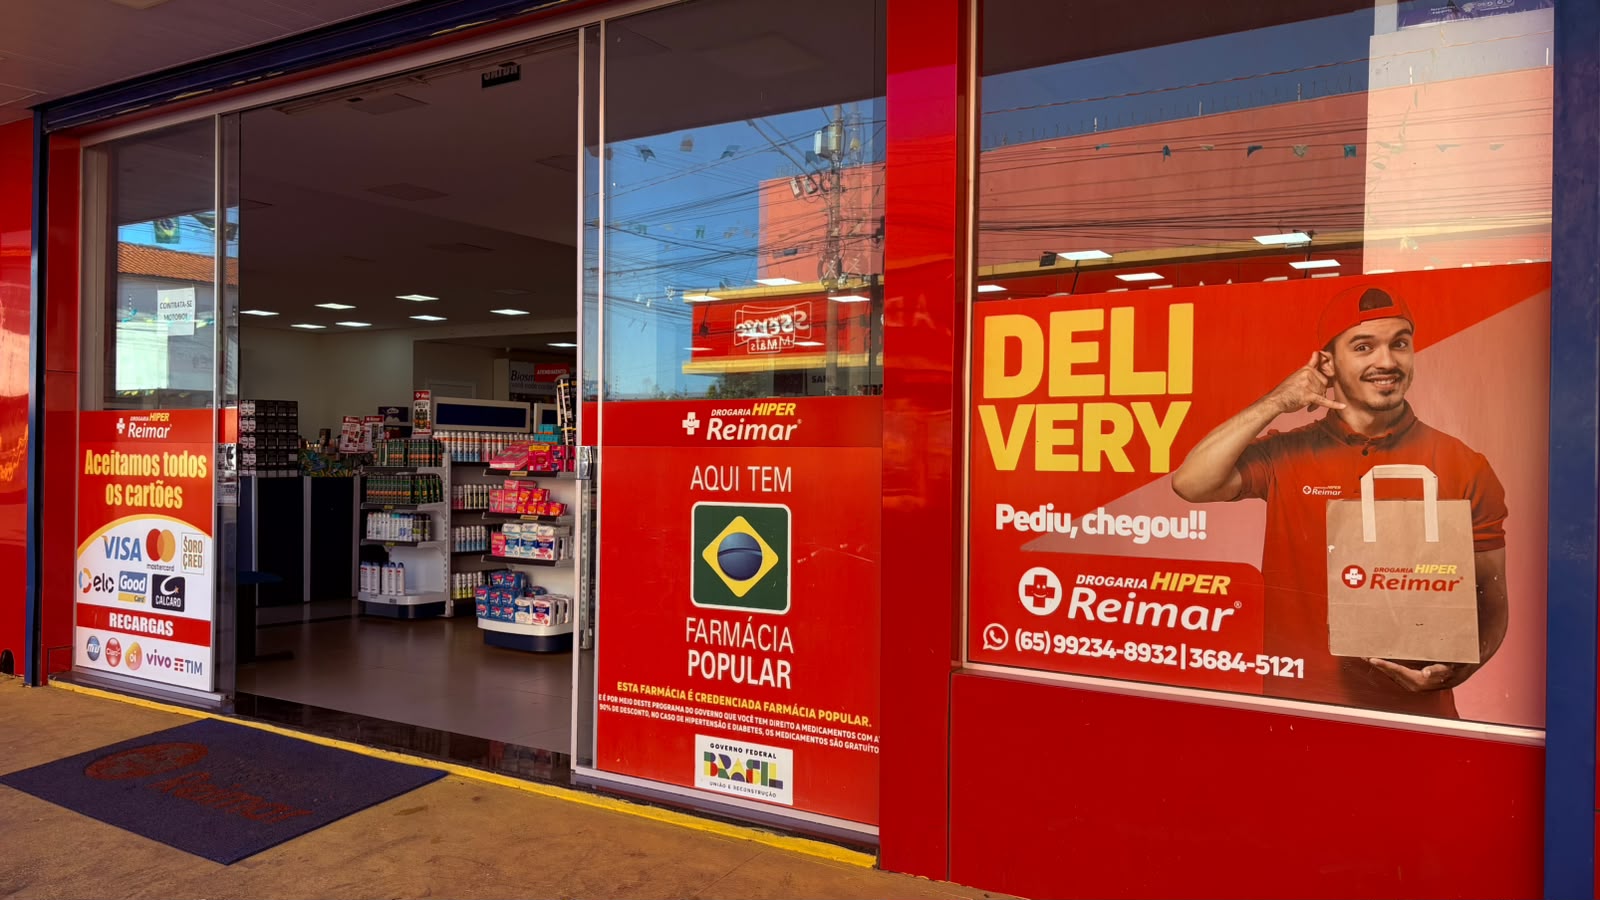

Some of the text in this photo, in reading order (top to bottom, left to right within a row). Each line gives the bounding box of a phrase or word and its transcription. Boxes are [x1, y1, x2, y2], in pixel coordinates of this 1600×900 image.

[159, 300, 192, 309] CONTRATA-SE
[983, 302, 1194, 399] DELI
[149, 412, 170, 422] HIPER
[752, 403, 796, 416] HIPER
[128, 422, 170, 438] Reimar
[706, 418, 798, 441] Reimar
[978, 400, 1192, 473] VERY
[84, 450, 207, 478] Aceitamos todos
[690, 466, 792, 492] AQUI TEM
[106, 480, 183, 510] os cartões
[996, 504, 1207, 544] Pediu, chegou!!
[102, 536, 142, 562] VISA
[146, 564, 174, 572] mastercard
[1414, 564, 1457, 574] HIPER
[120, 574, 146, 592] Good
[1076, 571, 1231, 596] DROGARIA HIPER
[1370, 574, 1460, 592] Reimar
[155, 595, 182, 608] CALCARD
[109, 612, 174, 637] RECARGAS
[686, 616, 794, 654] FARMÁCIA
[1014, 628, 1050, 654] (65)
[146, 649, 172, 668] vivo
[184, 660, 202, 676] TIM
[688, 650, 792, 689] POPULAR
[617, 682, 872, 728] ESTA FARMÁCIA É CREDENCIADA FARMÁCIA POPULAR.
[619, 697, 632, 705] MEIO
[634, 698, 651, 708] DESTE
[652, 701, 684, 712] PROGRAMA
[685, 707, 694, 715] DO
[694, 708, 722, 718] GOVERNO
[724, 712, 736, 721] QUE
[738, 714, 754, 724] VOCÊ
[755, 716, 768, 726] TEM
[769, 720, 794, 730] DIREITO
[802, 724, 856, 740] MEDICAMENTOS
[857, 733, 872, 742] COM
[620, 706, 650, 718] DESCONTO,
[651, 711, 660, 719] NO
[660, 712, 676, 721] CASO
[685, 716, 726, 730] HIPERTENSÃO
[732, 723, 764, 736] DIABETES,
[766, 728, 774, 736] OS
[776, 730, 828, 746] MEDICAMENTOS
[830, 737, 843, 748] SÃO
[710, 742, 777, 760] GOVERNO FEDERAL
[704, 751, 784, 790] BRASIL
[733, 786, 777, 798] RECONSTRUÇÃO
